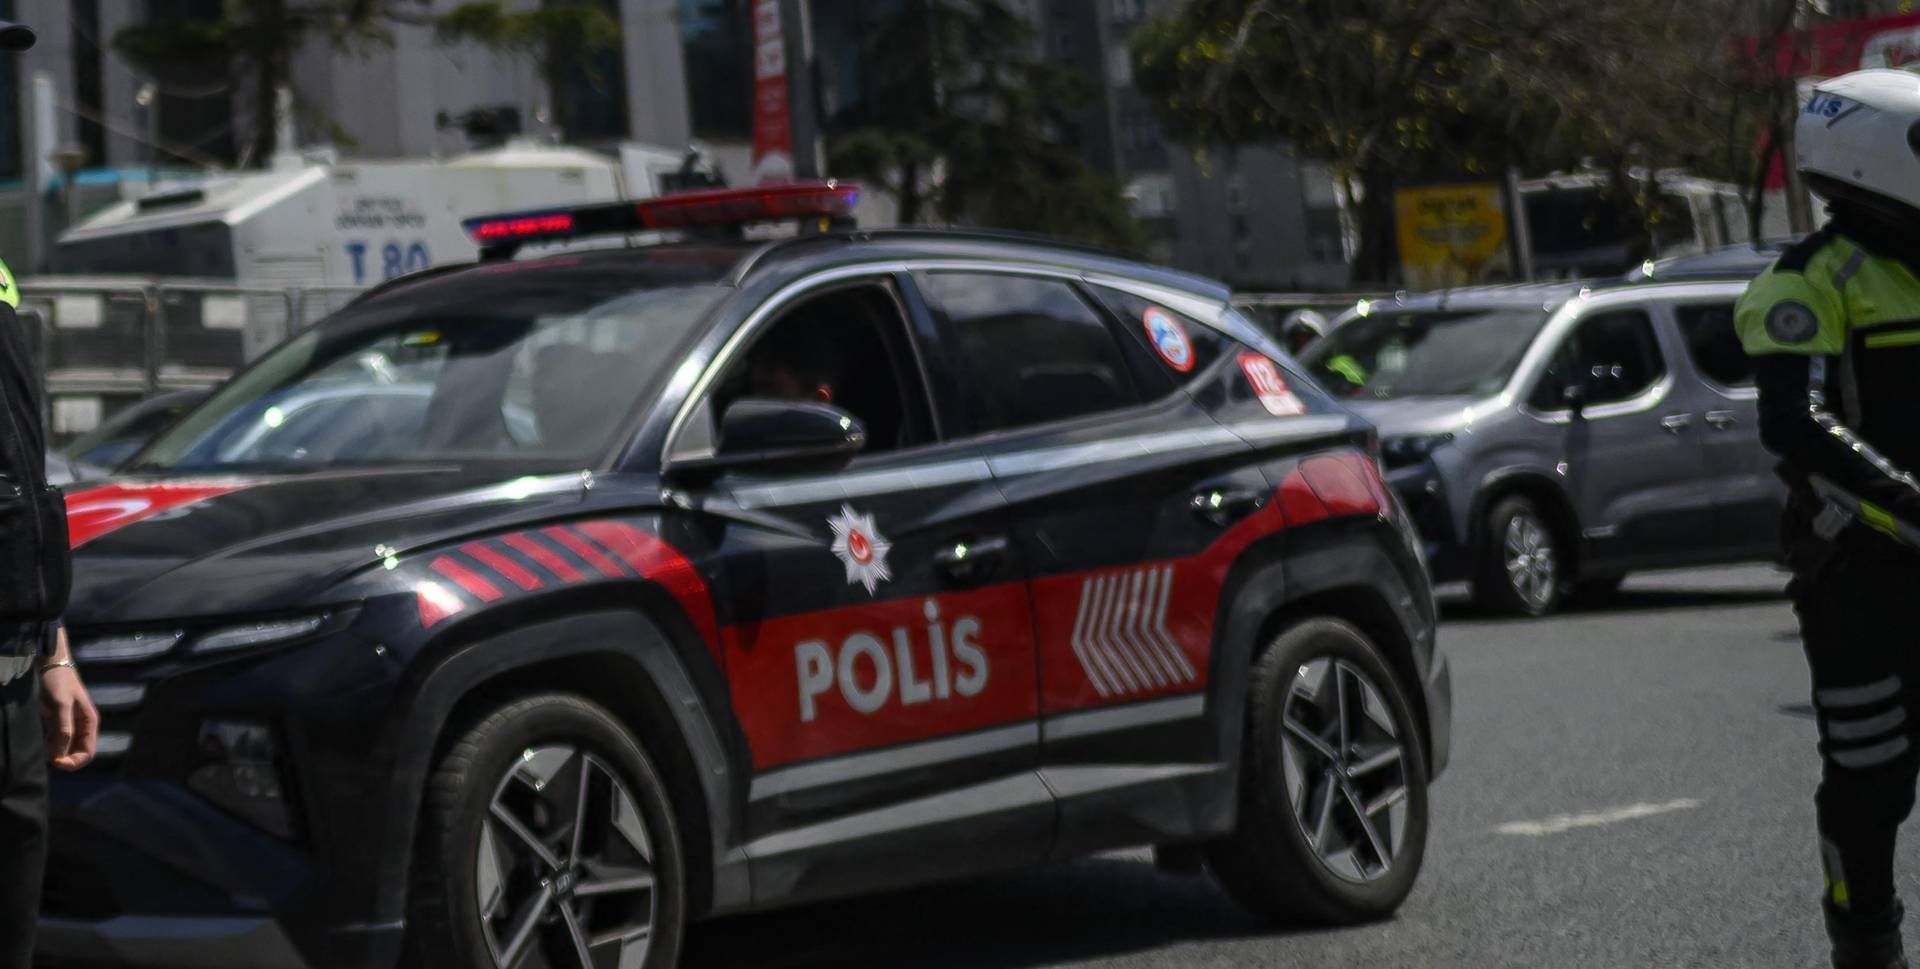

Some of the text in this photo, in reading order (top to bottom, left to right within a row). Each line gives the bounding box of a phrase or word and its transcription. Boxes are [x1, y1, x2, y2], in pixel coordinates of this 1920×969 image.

[345, 240, 430, 284] T 80
[1245, 361, 1283, 394] 112
[794, 597, 989, 722] POLİS
